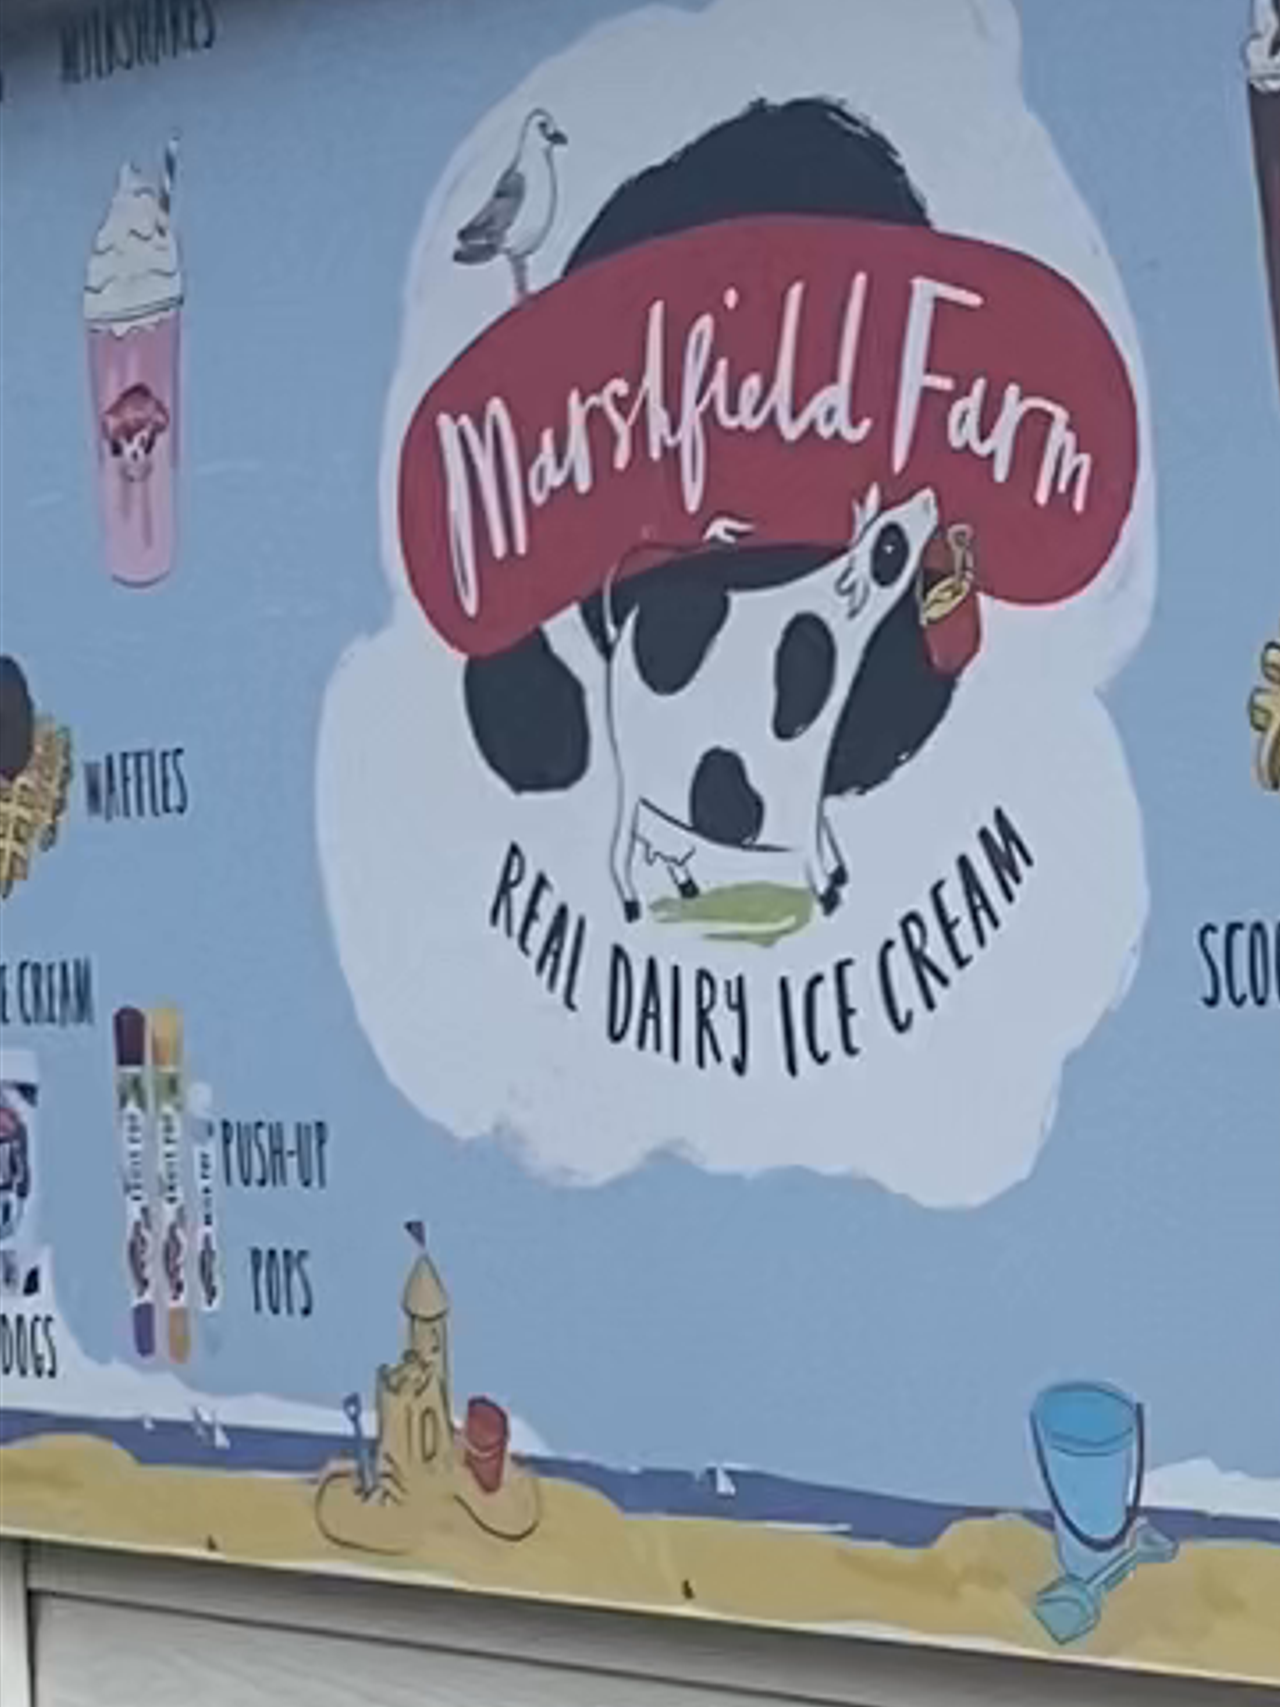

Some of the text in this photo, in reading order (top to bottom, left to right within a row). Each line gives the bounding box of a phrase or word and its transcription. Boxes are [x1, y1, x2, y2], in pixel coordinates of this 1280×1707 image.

[438, 272, 1092, 616] Marshfield Farm
[84, 748, 188, 823] WAFFLES
[489, 806, 1034, 1077] REAL DAIRY ICE CREAM
[221, 1120, 329, 1192] PUSH-UP
[251, 1247, 313, 1319] POPS
